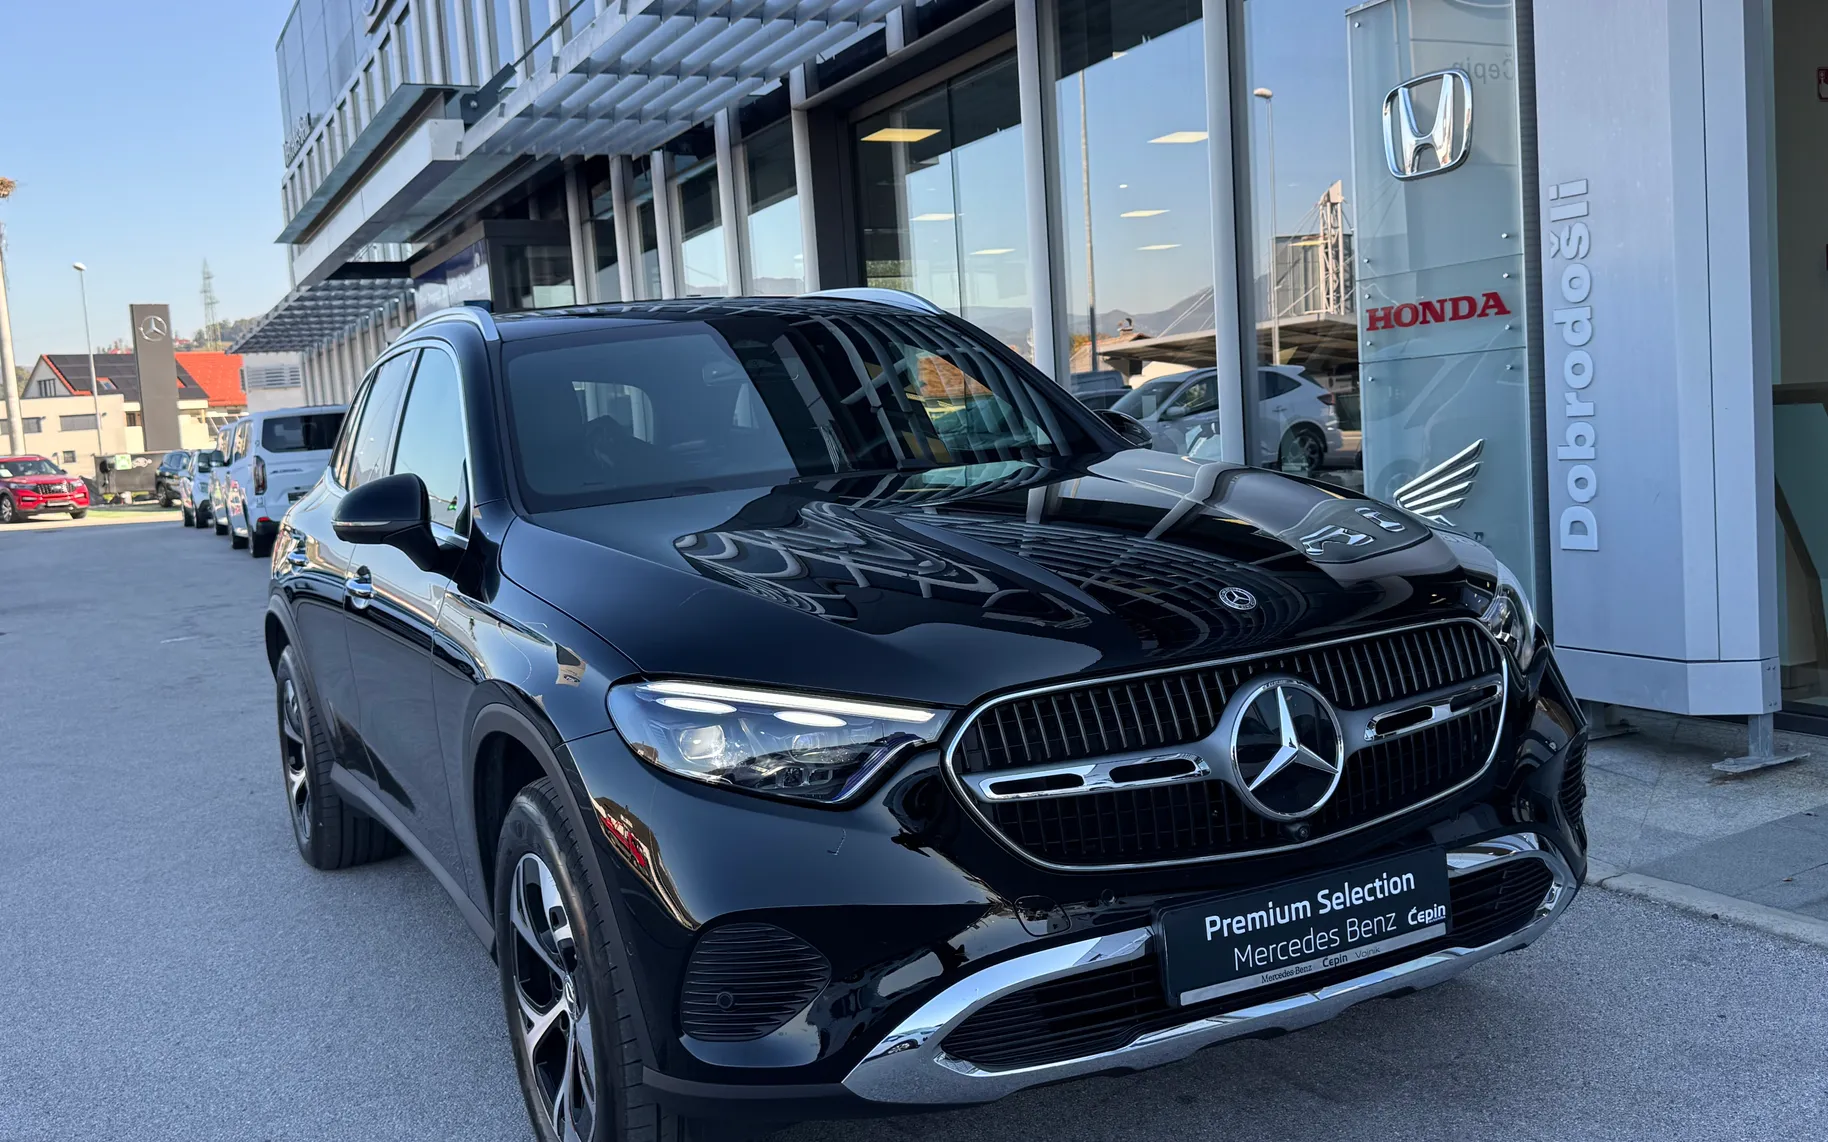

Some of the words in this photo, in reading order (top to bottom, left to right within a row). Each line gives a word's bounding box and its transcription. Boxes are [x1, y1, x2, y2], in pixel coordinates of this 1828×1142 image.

[1366, 291, 1510, 331] HONDA
[1549, 178, 1598, 551] Dobrodošli
[1205, 901, 1311, 941] Premium
[1318, 872, 1415, 915] Selection
[1235, 927, 1341, 971] Mercedes
[1347, 913, 1397, 942] Benz
